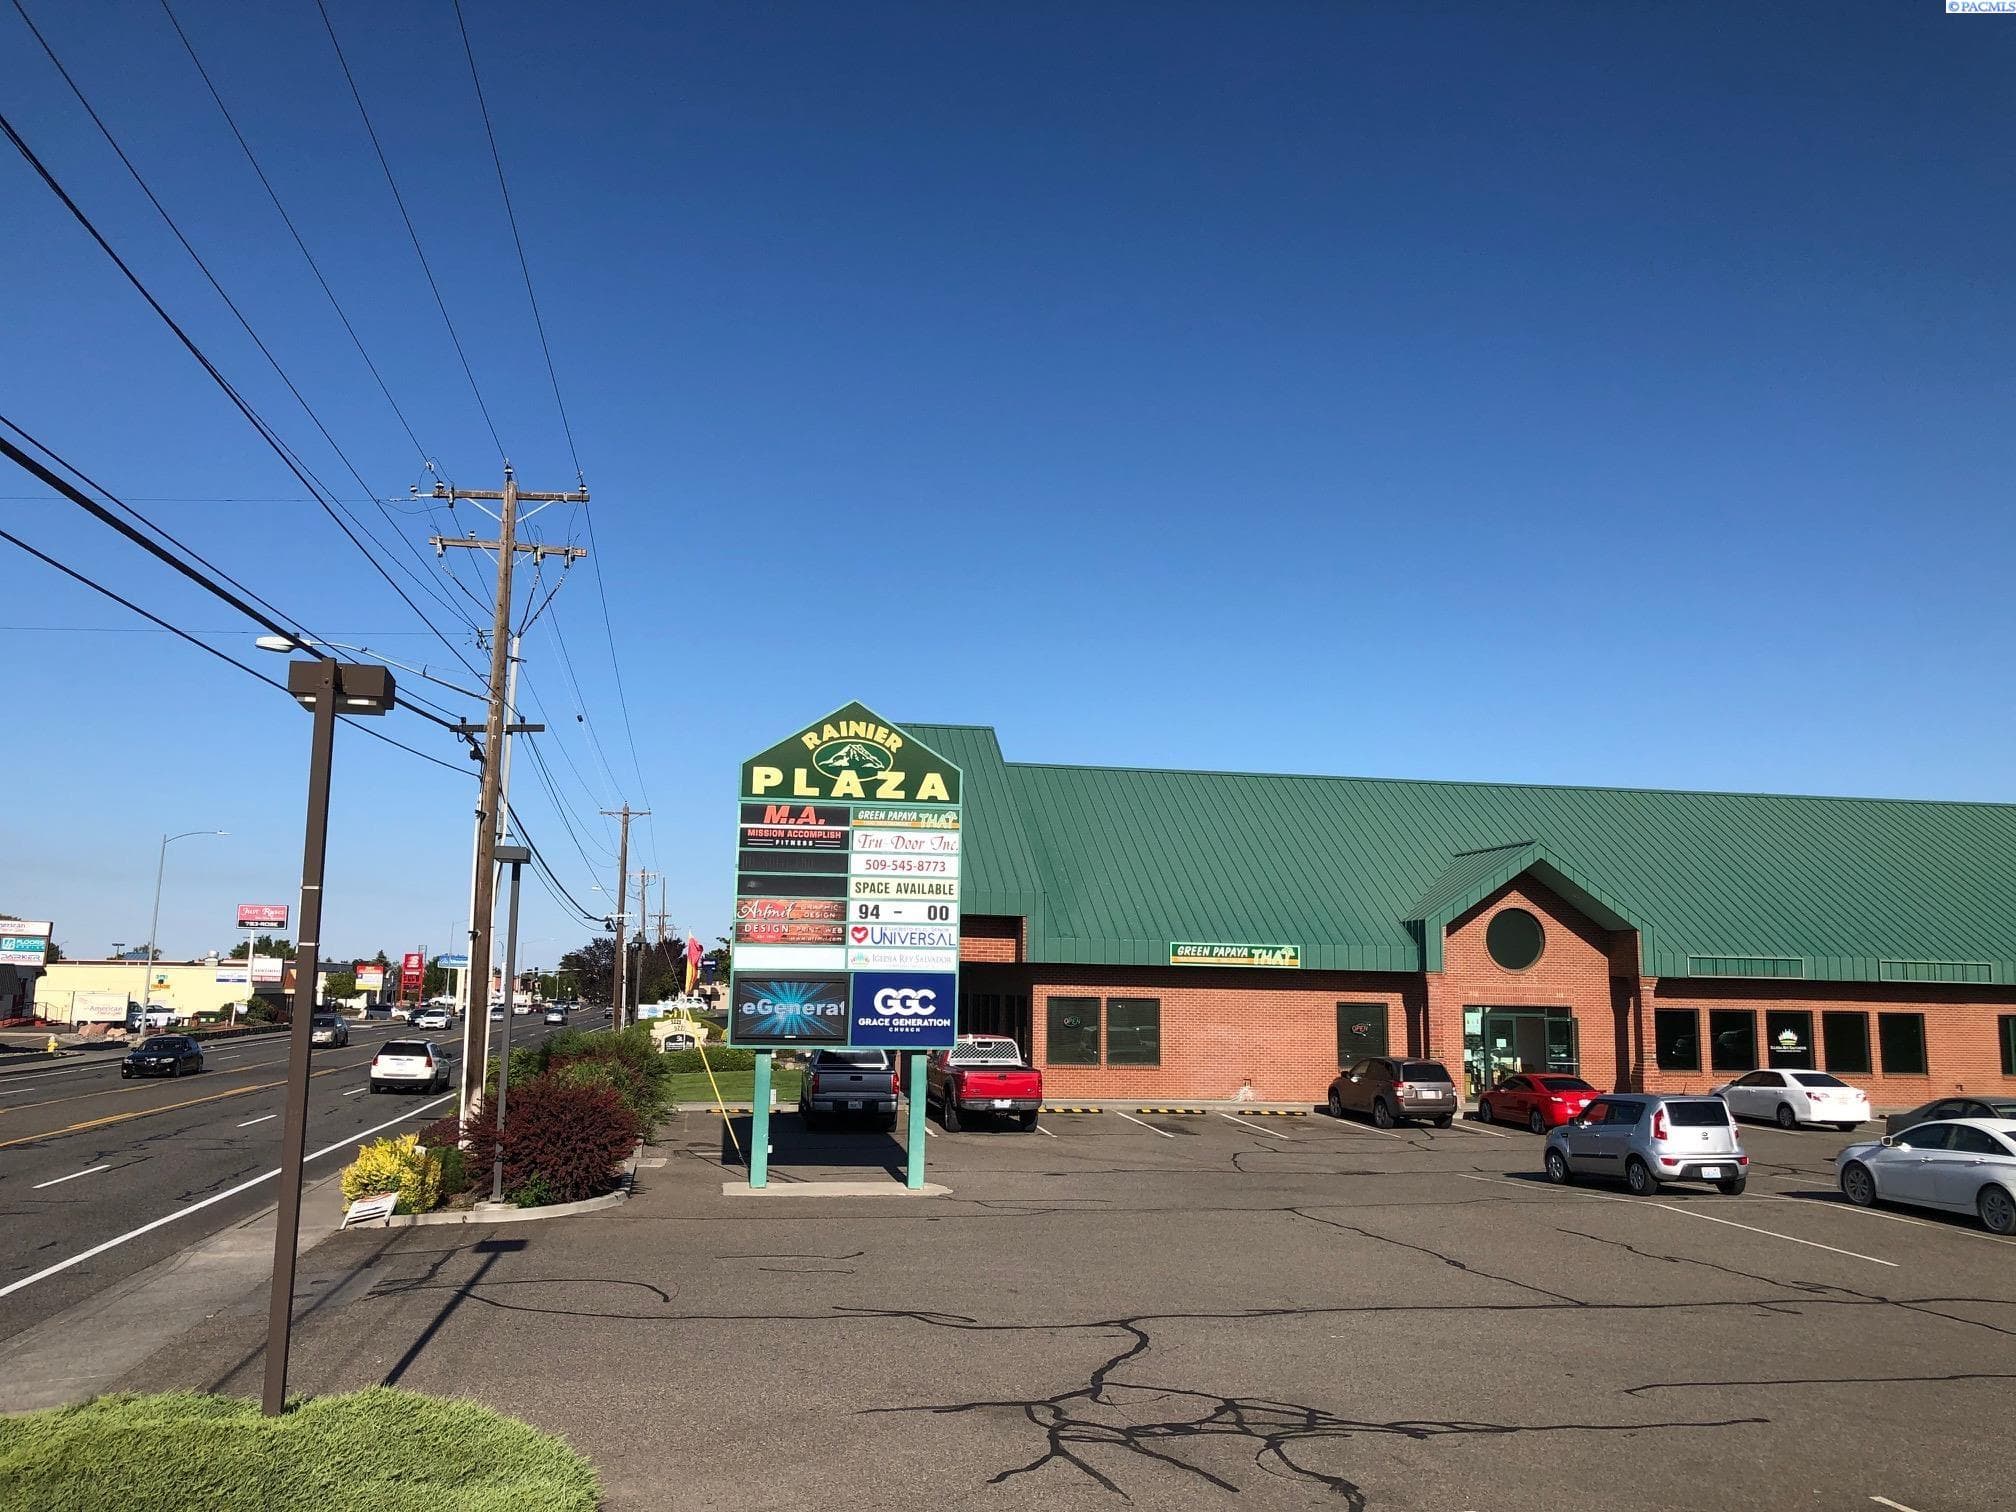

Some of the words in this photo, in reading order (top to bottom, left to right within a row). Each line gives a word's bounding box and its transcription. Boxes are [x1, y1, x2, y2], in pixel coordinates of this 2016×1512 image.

[801, 720, 903, 753] RAINIER
[752, 766, 950, 800] PLAZA
[763, 805, 826, 825] M.A.
[858, 810, 886, 820] GREEN
[887, 811, 917, 822] PAPAYA
[747, 829, 785, 838] MISSION
[786, 830, 842, 839] ACCOMPLISH
[775, 839, 814, 847] FITNESS
[858, 833, 883, 849] Tru
[890, 835, 925, 850] Door
[930, 835, 960, 851] Inc.
[864, 859, 947, 872] 509-545-8773
[855, 882, 890, 894] SPACE
[895, 882, 955, 896] AVAILABLE
[858, 903, 880, 920] 94
[927, 905, 949, 921] 00
[744, 923, 790, 933] DESIGN
[871, 926, 956, 946] UNIVERSAL
[1177, 945, 1210, 956] GREEN
[1212, 946, 1248, 957] PAPAYA
[874, 988, 937, 1016] GGC
[858, 1018, 890, 1026] GRACE
[892, 1018, 951, 1027] GENERATION
